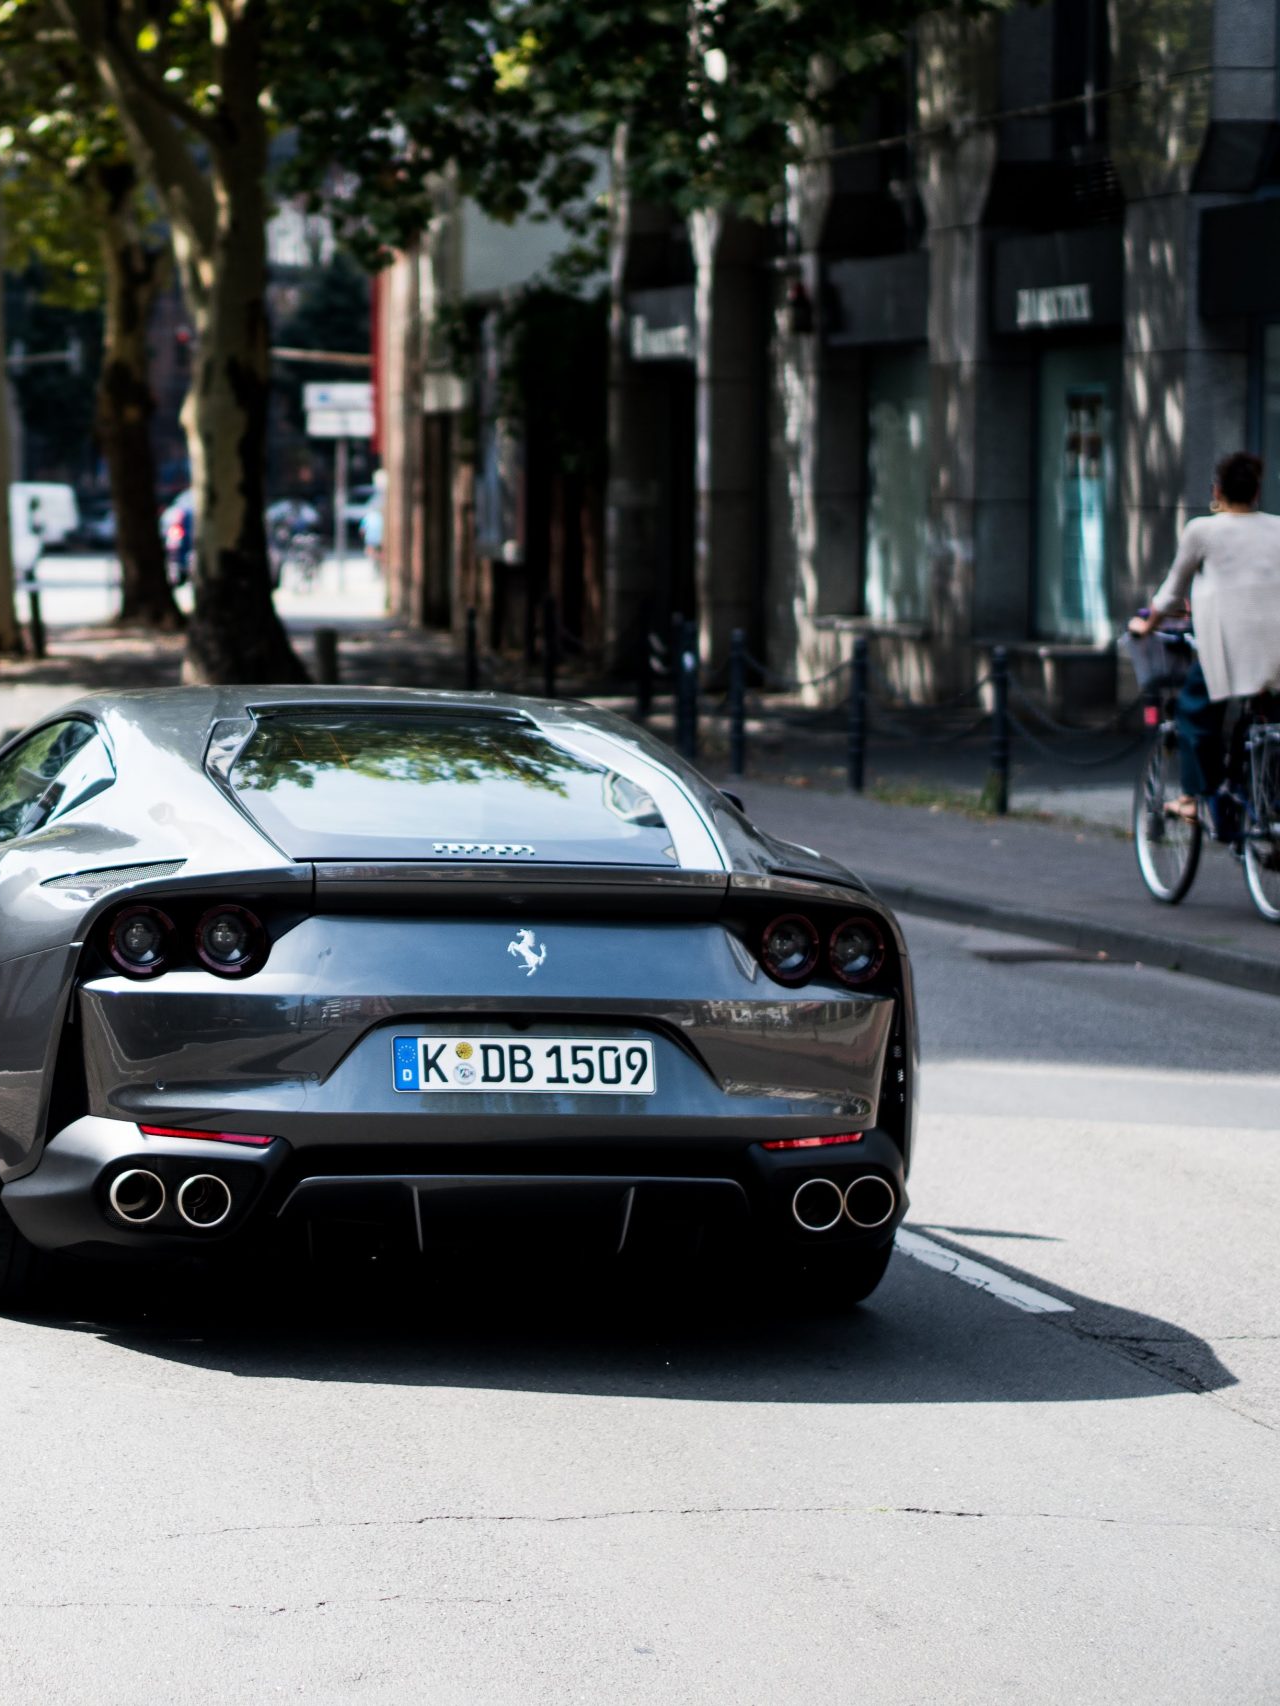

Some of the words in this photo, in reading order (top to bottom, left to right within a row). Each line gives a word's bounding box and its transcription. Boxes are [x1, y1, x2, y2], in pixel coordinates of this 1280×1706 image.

[402, 1068, 413, 1082] D
[422, 1043, 449, 1083] K
[479, 1043, 534, 1083] DB
[545, 1044, 648, 1086] 1509
